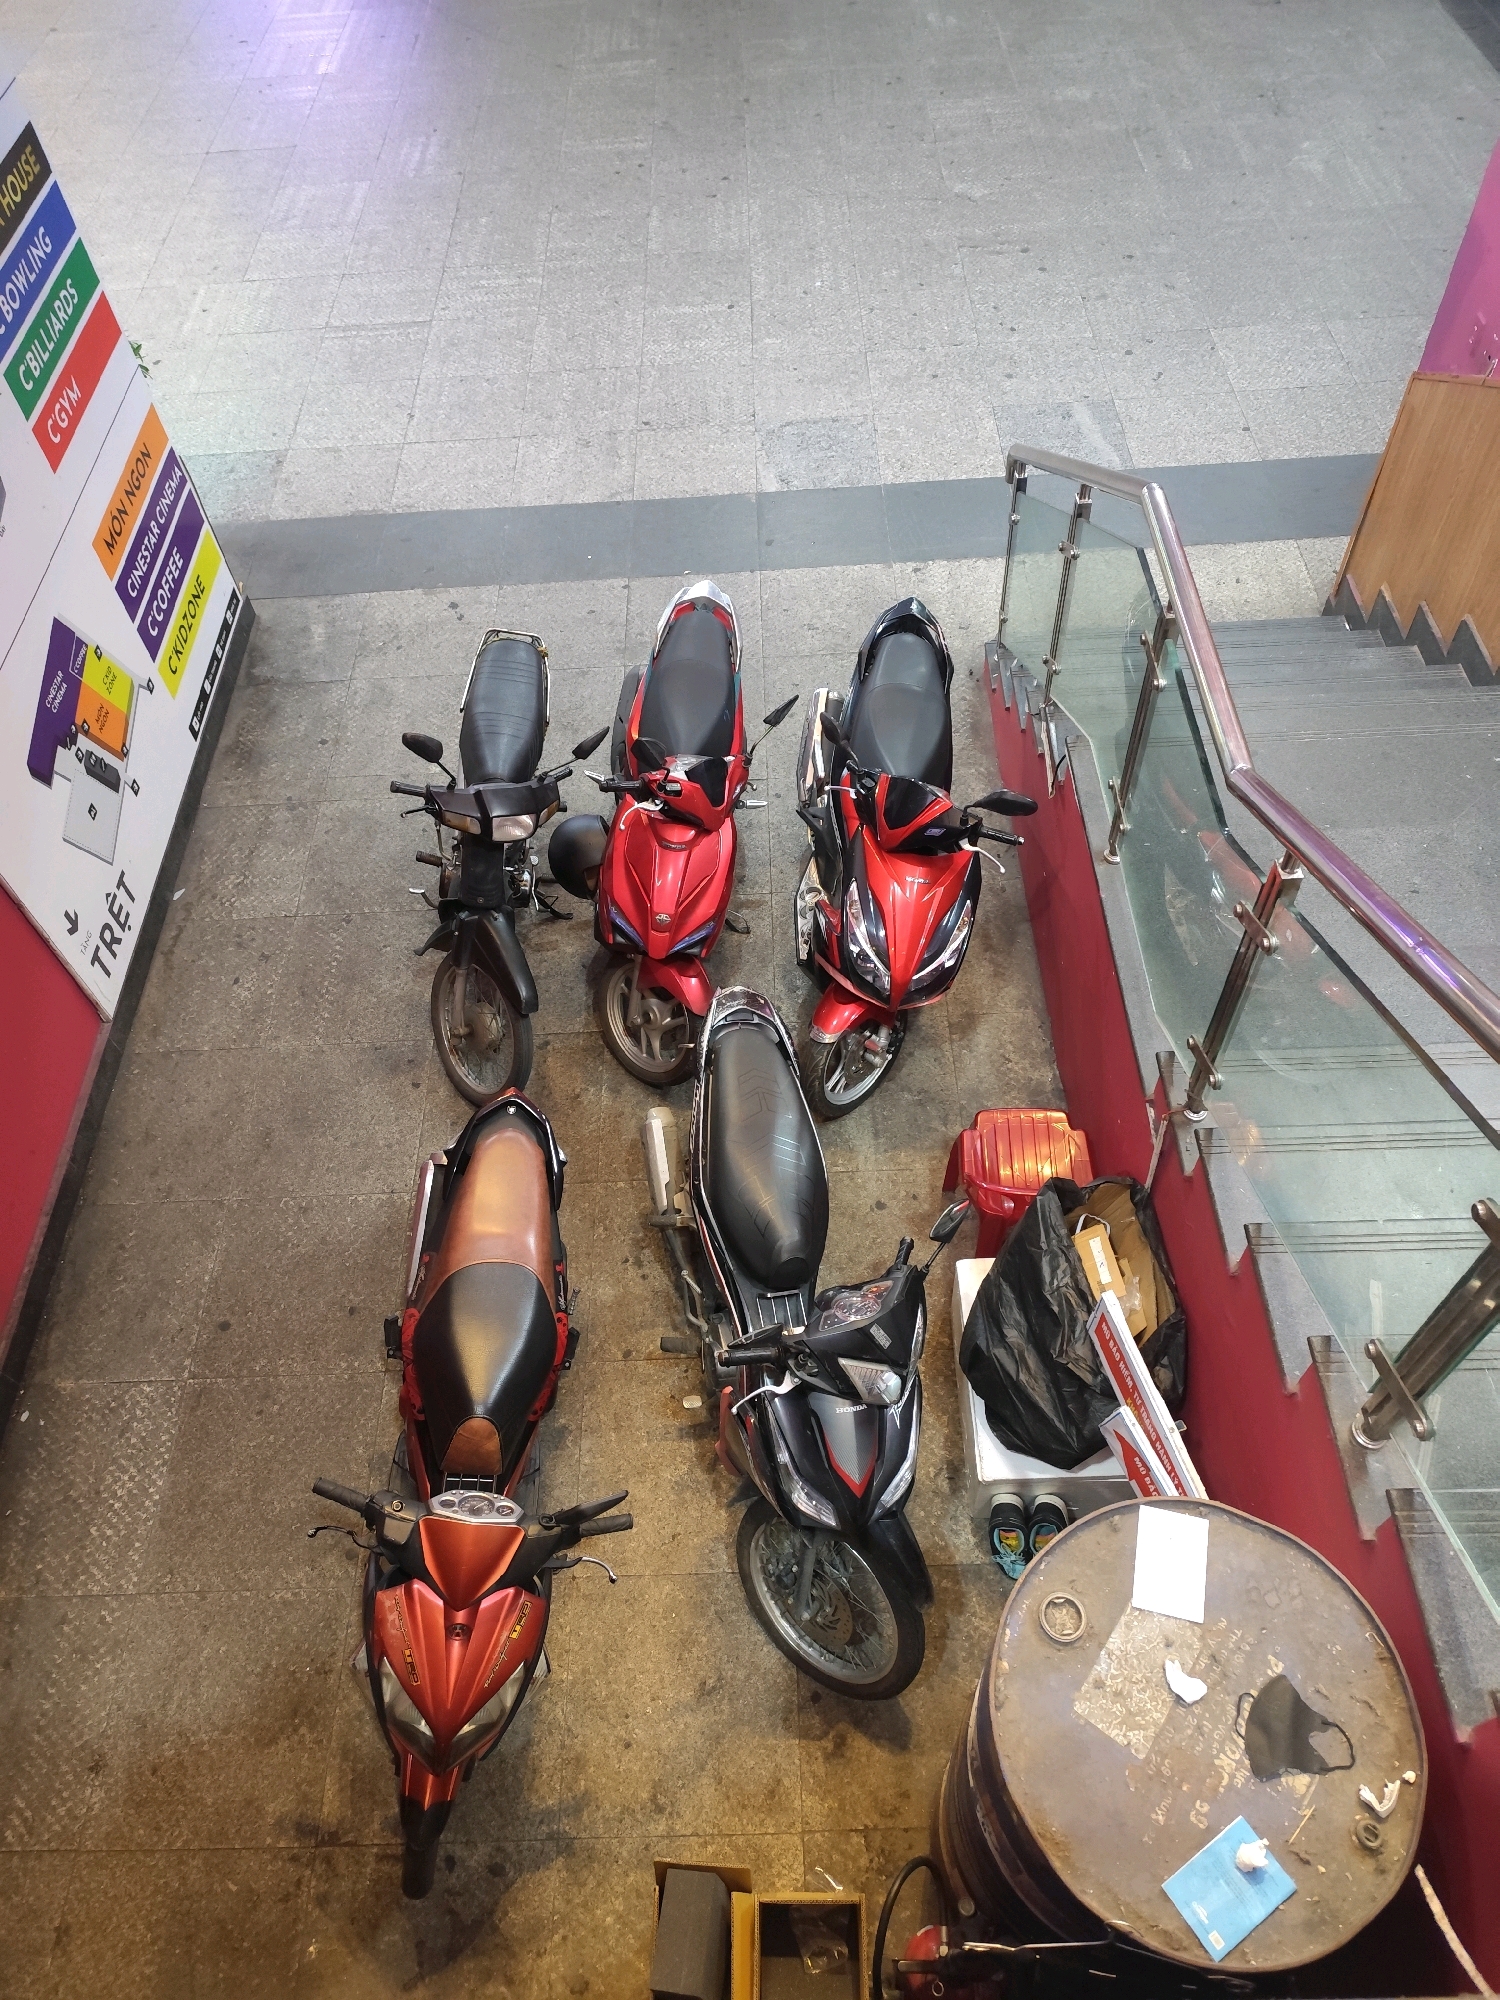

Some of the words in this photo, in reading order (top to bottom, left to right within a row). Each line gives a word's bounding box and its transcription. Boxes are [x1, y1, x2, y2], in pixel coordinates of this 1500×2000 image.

[1, 144, 41, 217] HOUSE
[18, 277, 79, 391] C'BILLIARDS
[47, 375, 82, 444] C'GYM
[103, 506, 129, 556] MÓN
[124, 442, 152, 506] NGON
[127, 522, 162, 598] CINESTAR
[158, 463, 183, 525] CINEMA
[148, 546, 184, 638] C'COFFEE
[167, 573, 206, 676] C'KIDZONE
[45, 670, 64, 708] CINESTAR
[51, 683, 68, 713] CINEMA
[99, 708, 110, 734] NGON
[90, 870, 137, 980] TRỆT
[834, 1403, 868, 1413] HONDA
[1139, 1406, 1157, 1441] TRANG
